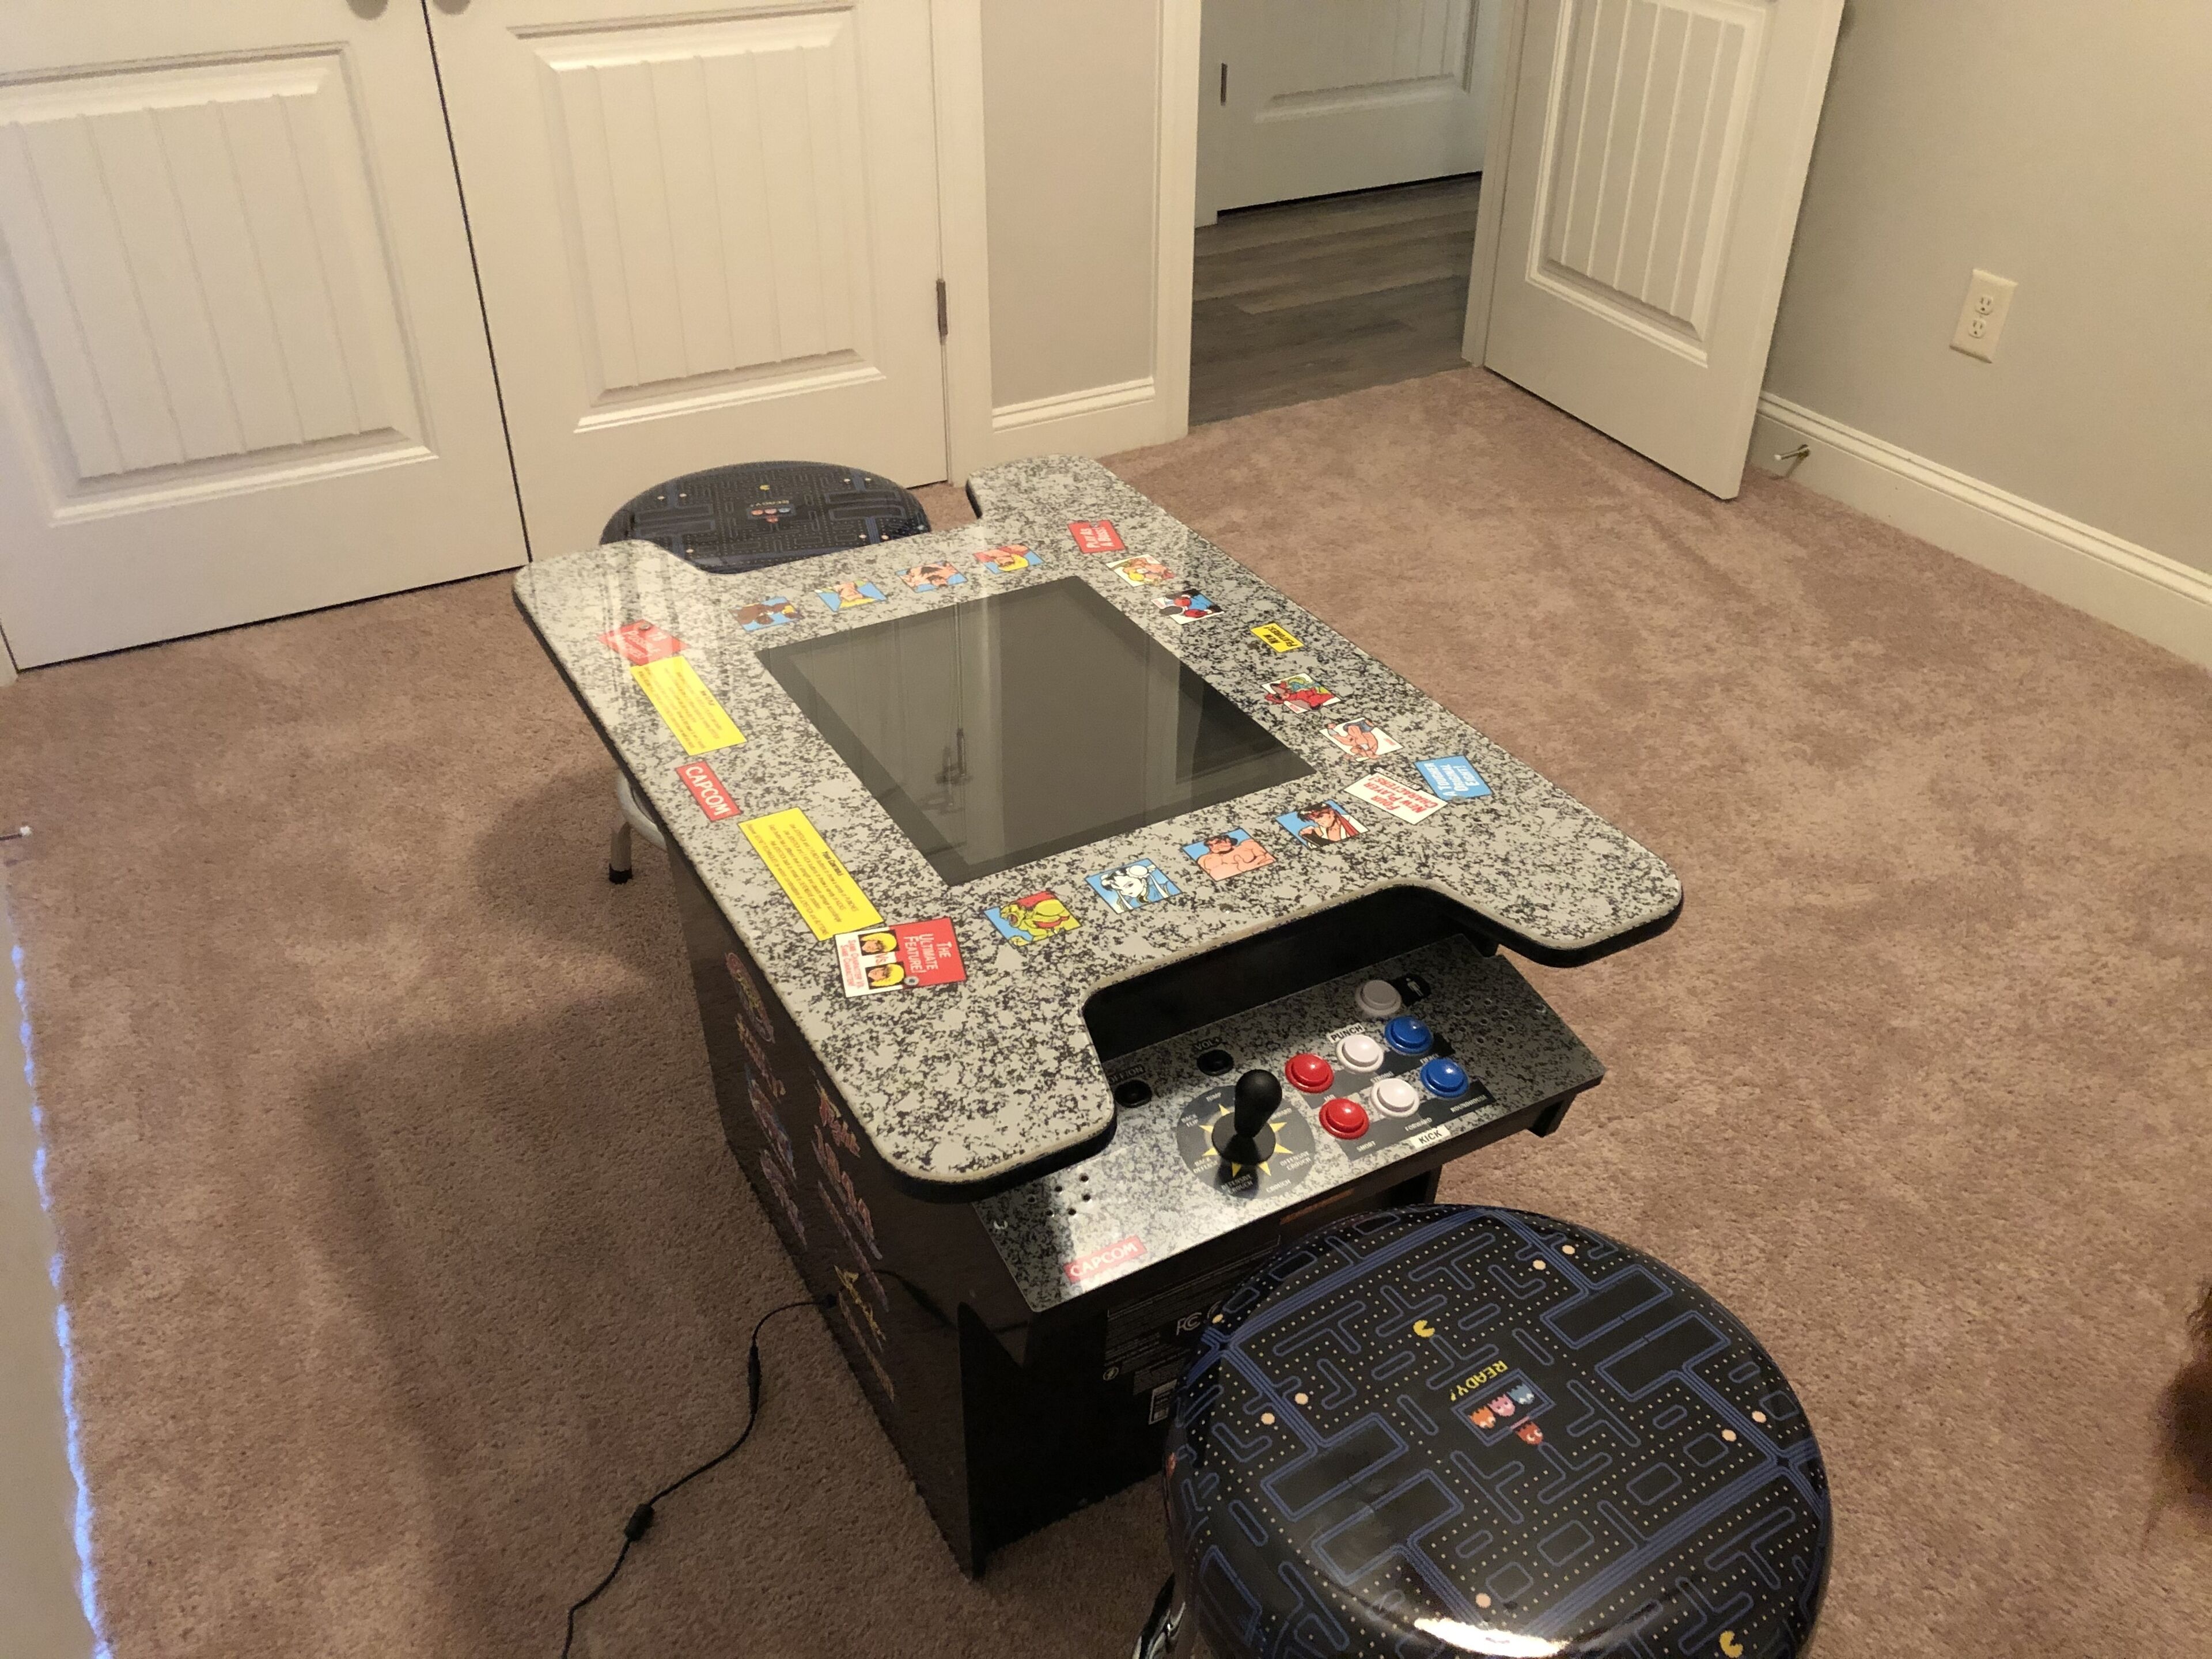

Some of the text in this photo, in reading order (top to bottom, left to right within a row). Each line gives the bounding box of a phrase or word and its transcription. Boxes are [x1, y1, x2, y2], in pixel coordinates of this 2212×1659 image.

[1423, 763, 1453, 790] TOUGHER
[685, 766, 730, 816] CAPCOM
[1363, 782, 1427, 813] NEW PLAYER
[1368, 775, 1439, 809] CHARACTERS!
[1370, 795, 1400, 811] FOUR
[903, 935, 926, 974] FEATURE!
[918, 933, 940, 971] ULTIMATE
[935, 941, 953, 958] THE
[1331, 1025, 1363, 1041] PUNCH
[1404, 1117, 1433, 1131] FORWARD
[1418, 1130, 1442, 1144] KICK
[1357, 1141, 1376, 1152] SHORT
[1266, 1179, 1291, 1193] CROUCH
[1070, 1242, 1138, 1277] CAPCOM
[1449, 1359, 1509, 1402] READY!
